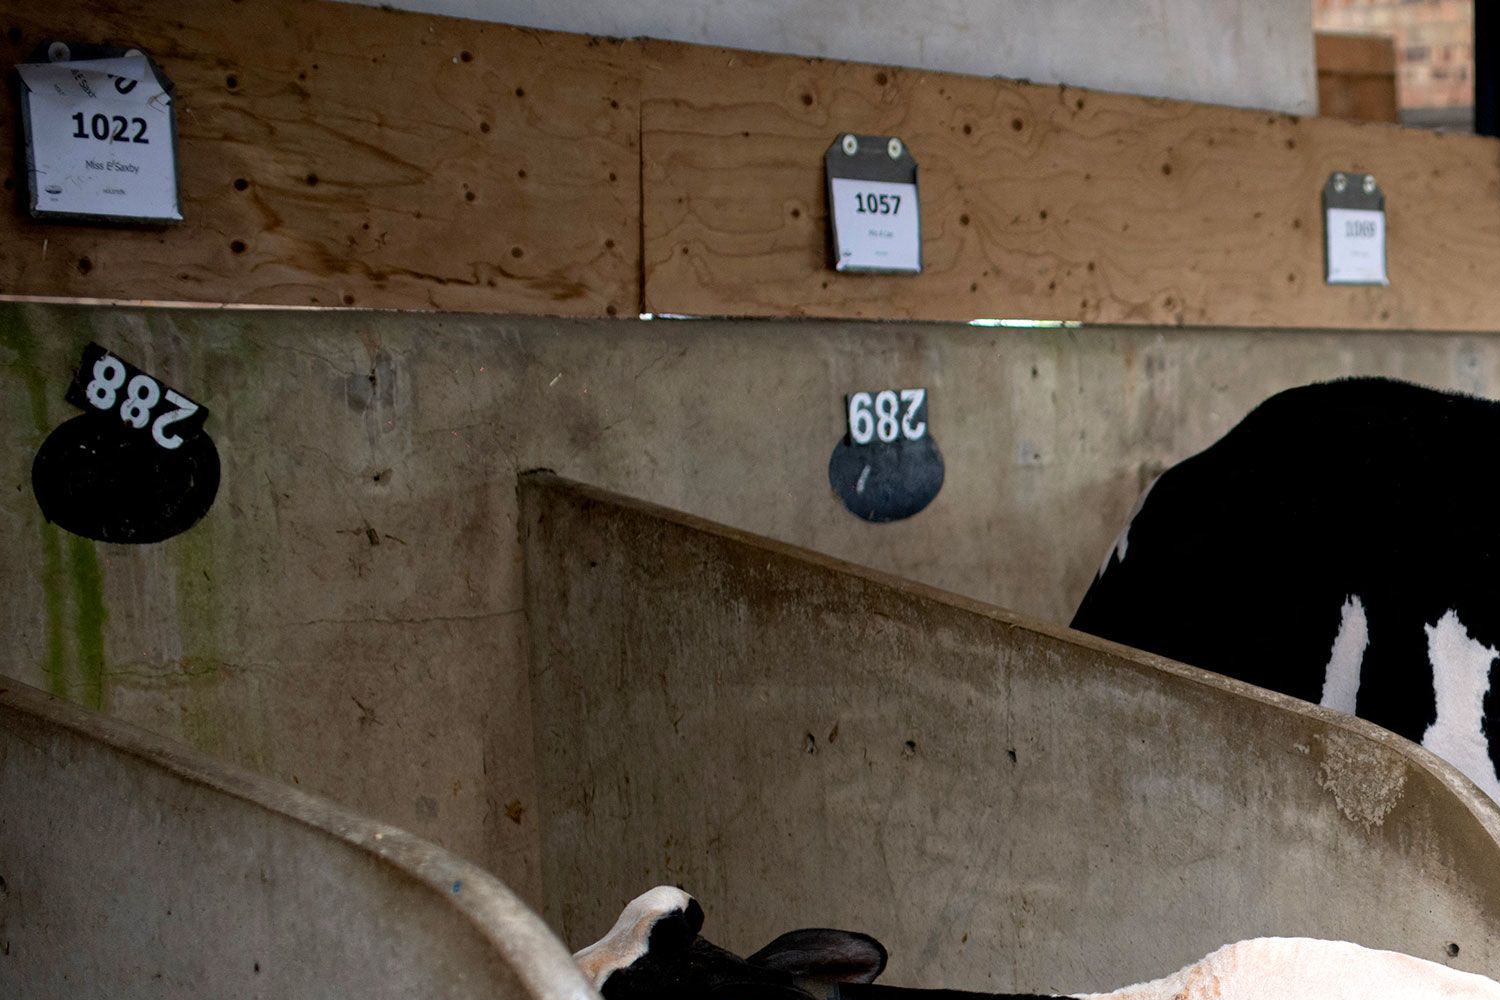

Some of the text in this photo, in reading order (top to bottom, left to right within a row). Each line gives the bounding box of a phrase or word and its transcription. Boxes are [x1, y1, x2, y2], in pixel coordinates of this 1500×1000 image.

[71, 112, 150, 145] 1022
[85, 159, 104, 171] Miss
[855, 192, 902, 216] 1057
[86, 354, 200, 450] 288
[850, 388, 926, 444] 289
